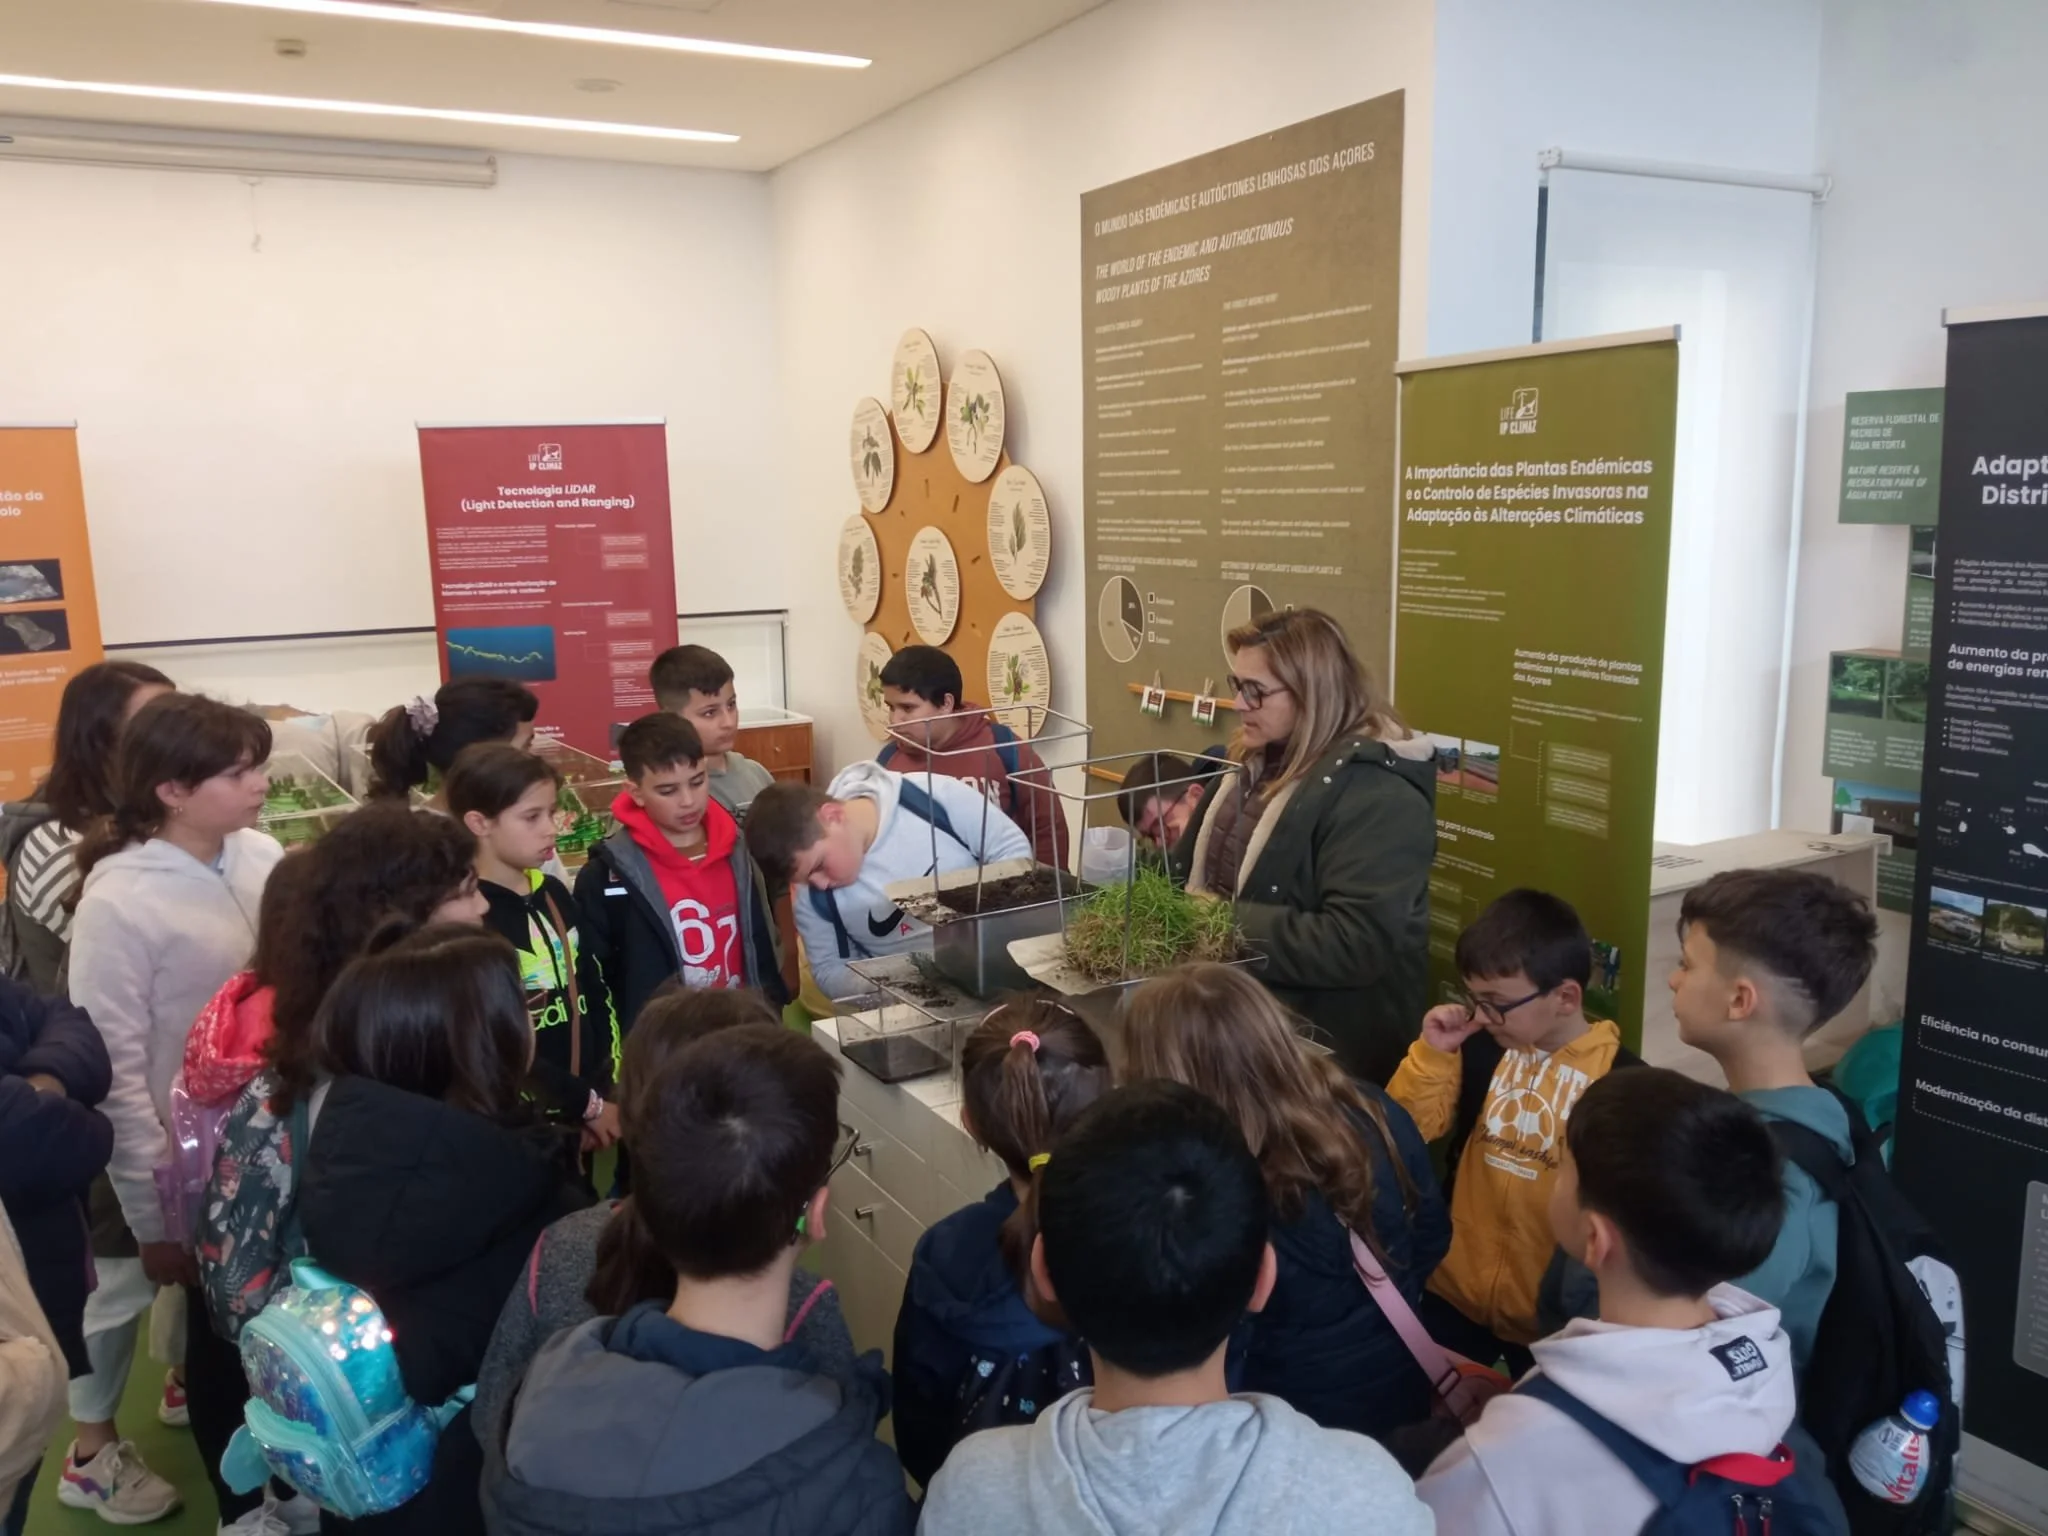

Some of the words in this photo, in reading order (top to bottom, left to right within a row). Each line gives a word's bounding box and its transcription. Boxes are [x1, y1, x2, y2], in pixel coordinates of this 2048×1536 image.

[1095, 222, 1100, 236] O
[1101, 214, 1128, 235] MUNDO
[1129, 209, 1144, 228] DAS
[1145, 194, 1190, 222] ENDÉMICAS
[1191, 193, 1198, 209] E
[1198, 175, 1255, 207] AUTÓCTONES
[1257, 161, 1307, 192] LENHOSAS
[1309, 154, 1330, 176] DOS
[1332, 141, 1375, 172] AÇORES
[1096, 265, 1109, 281] THE
[1110, 257, 1136, 277] WORLD
[1136, 253, 1147, 271] OF
[1147, 250, 1162, 268] THE
[1162, 241, 1199, 265] ENDEMIC
[1199, 236, 1218, 256] AND
[1218, 217, 1294, 252] AUTHOCTONOUS
[1096, 285, 1120, 305] WOODY
[1121, 279, 1150, 299] PLANTS
[1150, 276, 1162, 293] OF
[1163, 273, 1177, 290] THE
[1178, 265, 1211, 288] AZORES
[1500, 406, 1515, 421] LIFE
[1851, 416, 1883, 425] RESERVA
[1885, 413, 1926, 424] FLORESTAL
[1929, 413, 1940, 423] DE
[1499, 421, 1508, 435] IP
[1509, 420, 1537, 435] CLIMAZ
[1850, 428, 1881, 438] RECREIO
[1882, 427, 1892, 437] DE
[1871, 440, 1906, 450] RETORTA
[1406, 465, 1413, 480] A
[1414, 461, 1488, 484] Importância
[1490, 462, 1513, 478] das
[1516, 460, 1568, 476] Plantas
[1570, 456, 1653, 475] Endémicas
[1848, 465, 1878, 475] NATURE
[1878, 465, 1913, 475] RESERVE
[1971, 454, 2048, 481] Adapt
[497, 485, 563, 497] Tecnologia
[1847, 477, 1894, 488] RECREATION
[1894, 477, 1915, 488] PARK
[1916, 477, 1927, 488] OF
[1406, 489, 1412, 500] e
[1414, 489, 1421, 500] o
[1423, 484, 1474, 501] Controlo
[1476, 485, 1491, 500] de
[1493, 483, 1550, 504] Espécies
[1553, 484, 1623, 500] Invasoras
[1626, 485, 1649, 499] na
[1868, 490, 1903, 500] RETORTA
[1982, 483, 2048, 505] Distri
[461, 498, 496, 513] (Light
[497, 499, 555, 509] Detection
[556, 497, 579, 508] and
[582, 495, 635, 510] Ranging)
[1407, 507, 1471, 527] Adaptação
[1473, 506, 1488, 522] às
[1490, 506, 1561, 528] Alterações
[1564, 505, 1645, 524] Climáticas
[1514, 648, 1546, 660] Aumento
[1547, 651, 1558, 662] da
[1559, 654, 1597, 668] produção
[1598, 658, 1608, 668] de
[1609, 661, 1643, 672] plantas
[1948, 643, 2008, 659] Aumento
[2010, 648, 2029, 661] da
[2032, 652, 2048, 664] pr
[1514, 661, 1553, 673] endémicas
[1554, 666, 1570, 676] nos
[1571, 668, 1600, 680] viveiros
[1600, 671, 1639, 685] florestais
[1947, 659, 1963, 670] de
[1965, 661, 2023, 678] energias
[1513, 672, 1525, 682] dos
[1526, 674, 1551, 687] Açores
[1467, 826, 1495, 841] controlo
[1920, 1014, 1979, 1040] Eficiência
[1982, 1033, 2000, 1045] no
[2002, 1038, 2048, 1058] consu
[1915, 1078, 2001, 1113] Modernização
[2003, 1106, 2022, 1120] da
